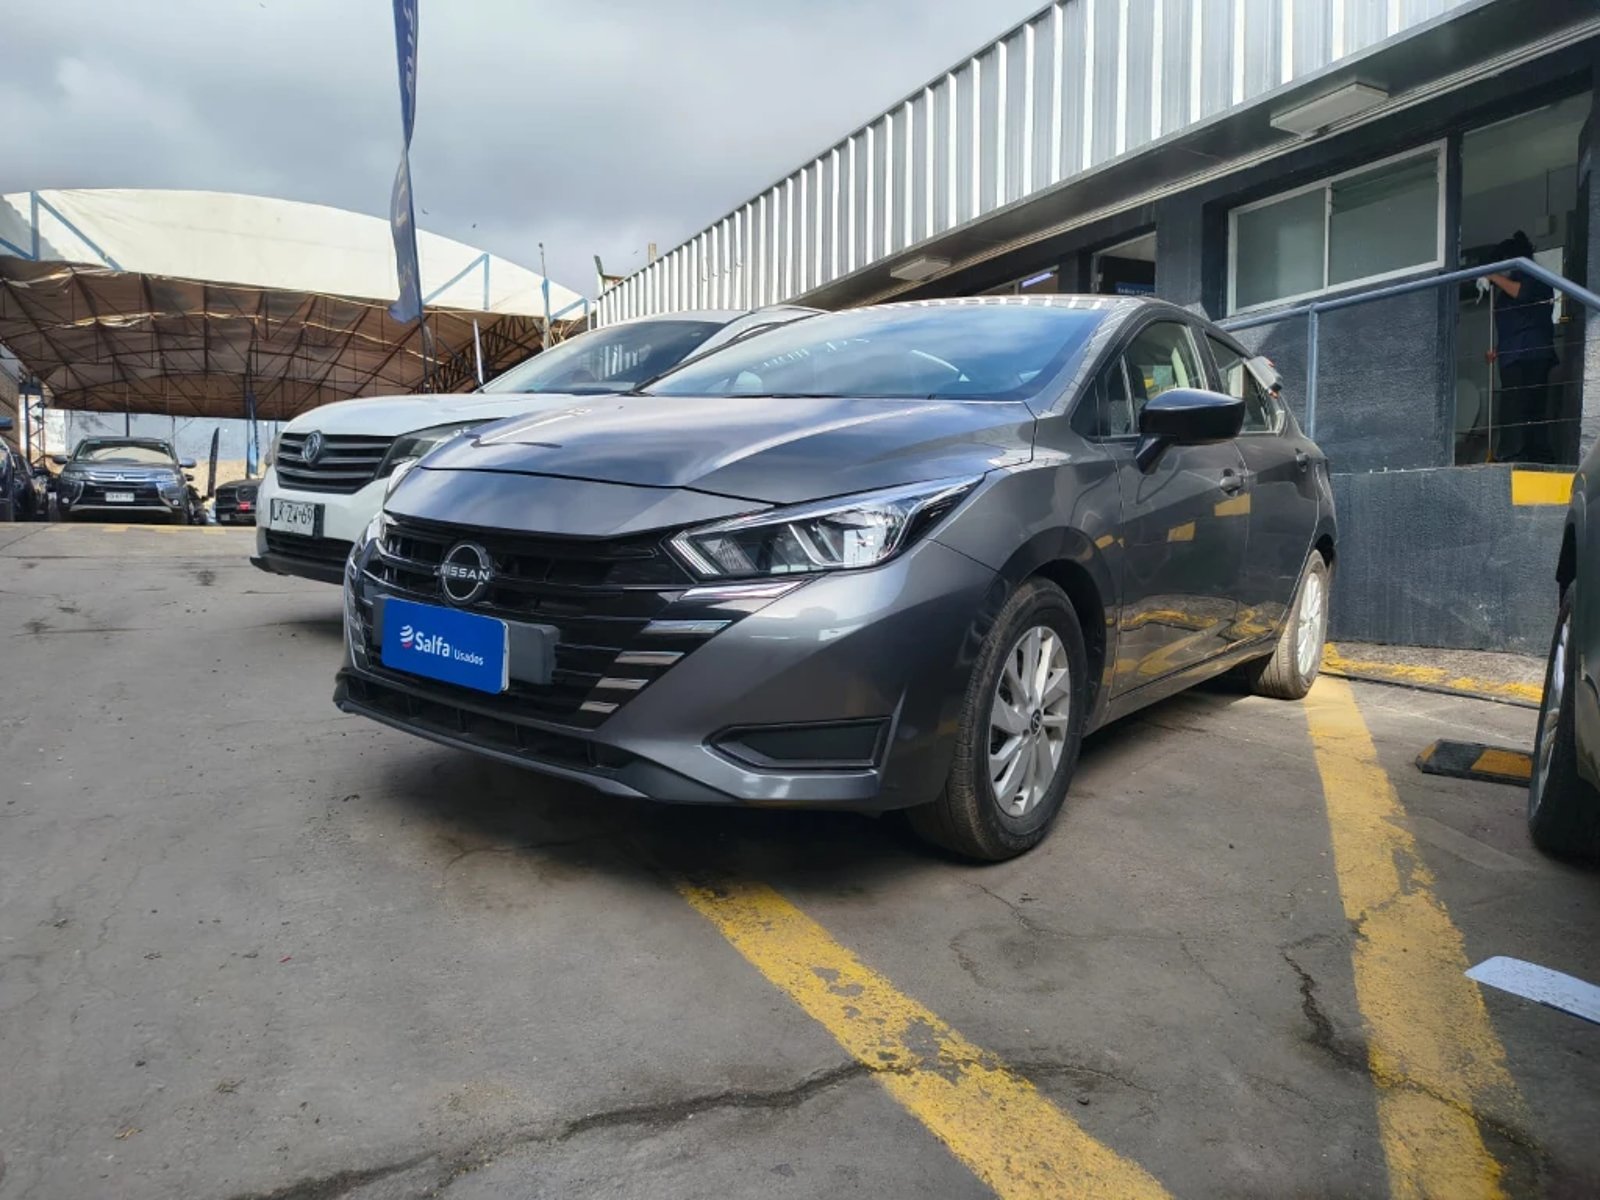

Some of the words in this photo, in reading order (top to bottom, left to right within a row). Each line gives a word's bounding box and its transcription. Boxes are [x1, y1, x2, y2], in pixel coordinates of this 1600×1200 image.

[441, 563, 490, 581] NISSAN
[415, 632, 450, 657] Salfa
[454, 649, 484, 666] Usados
